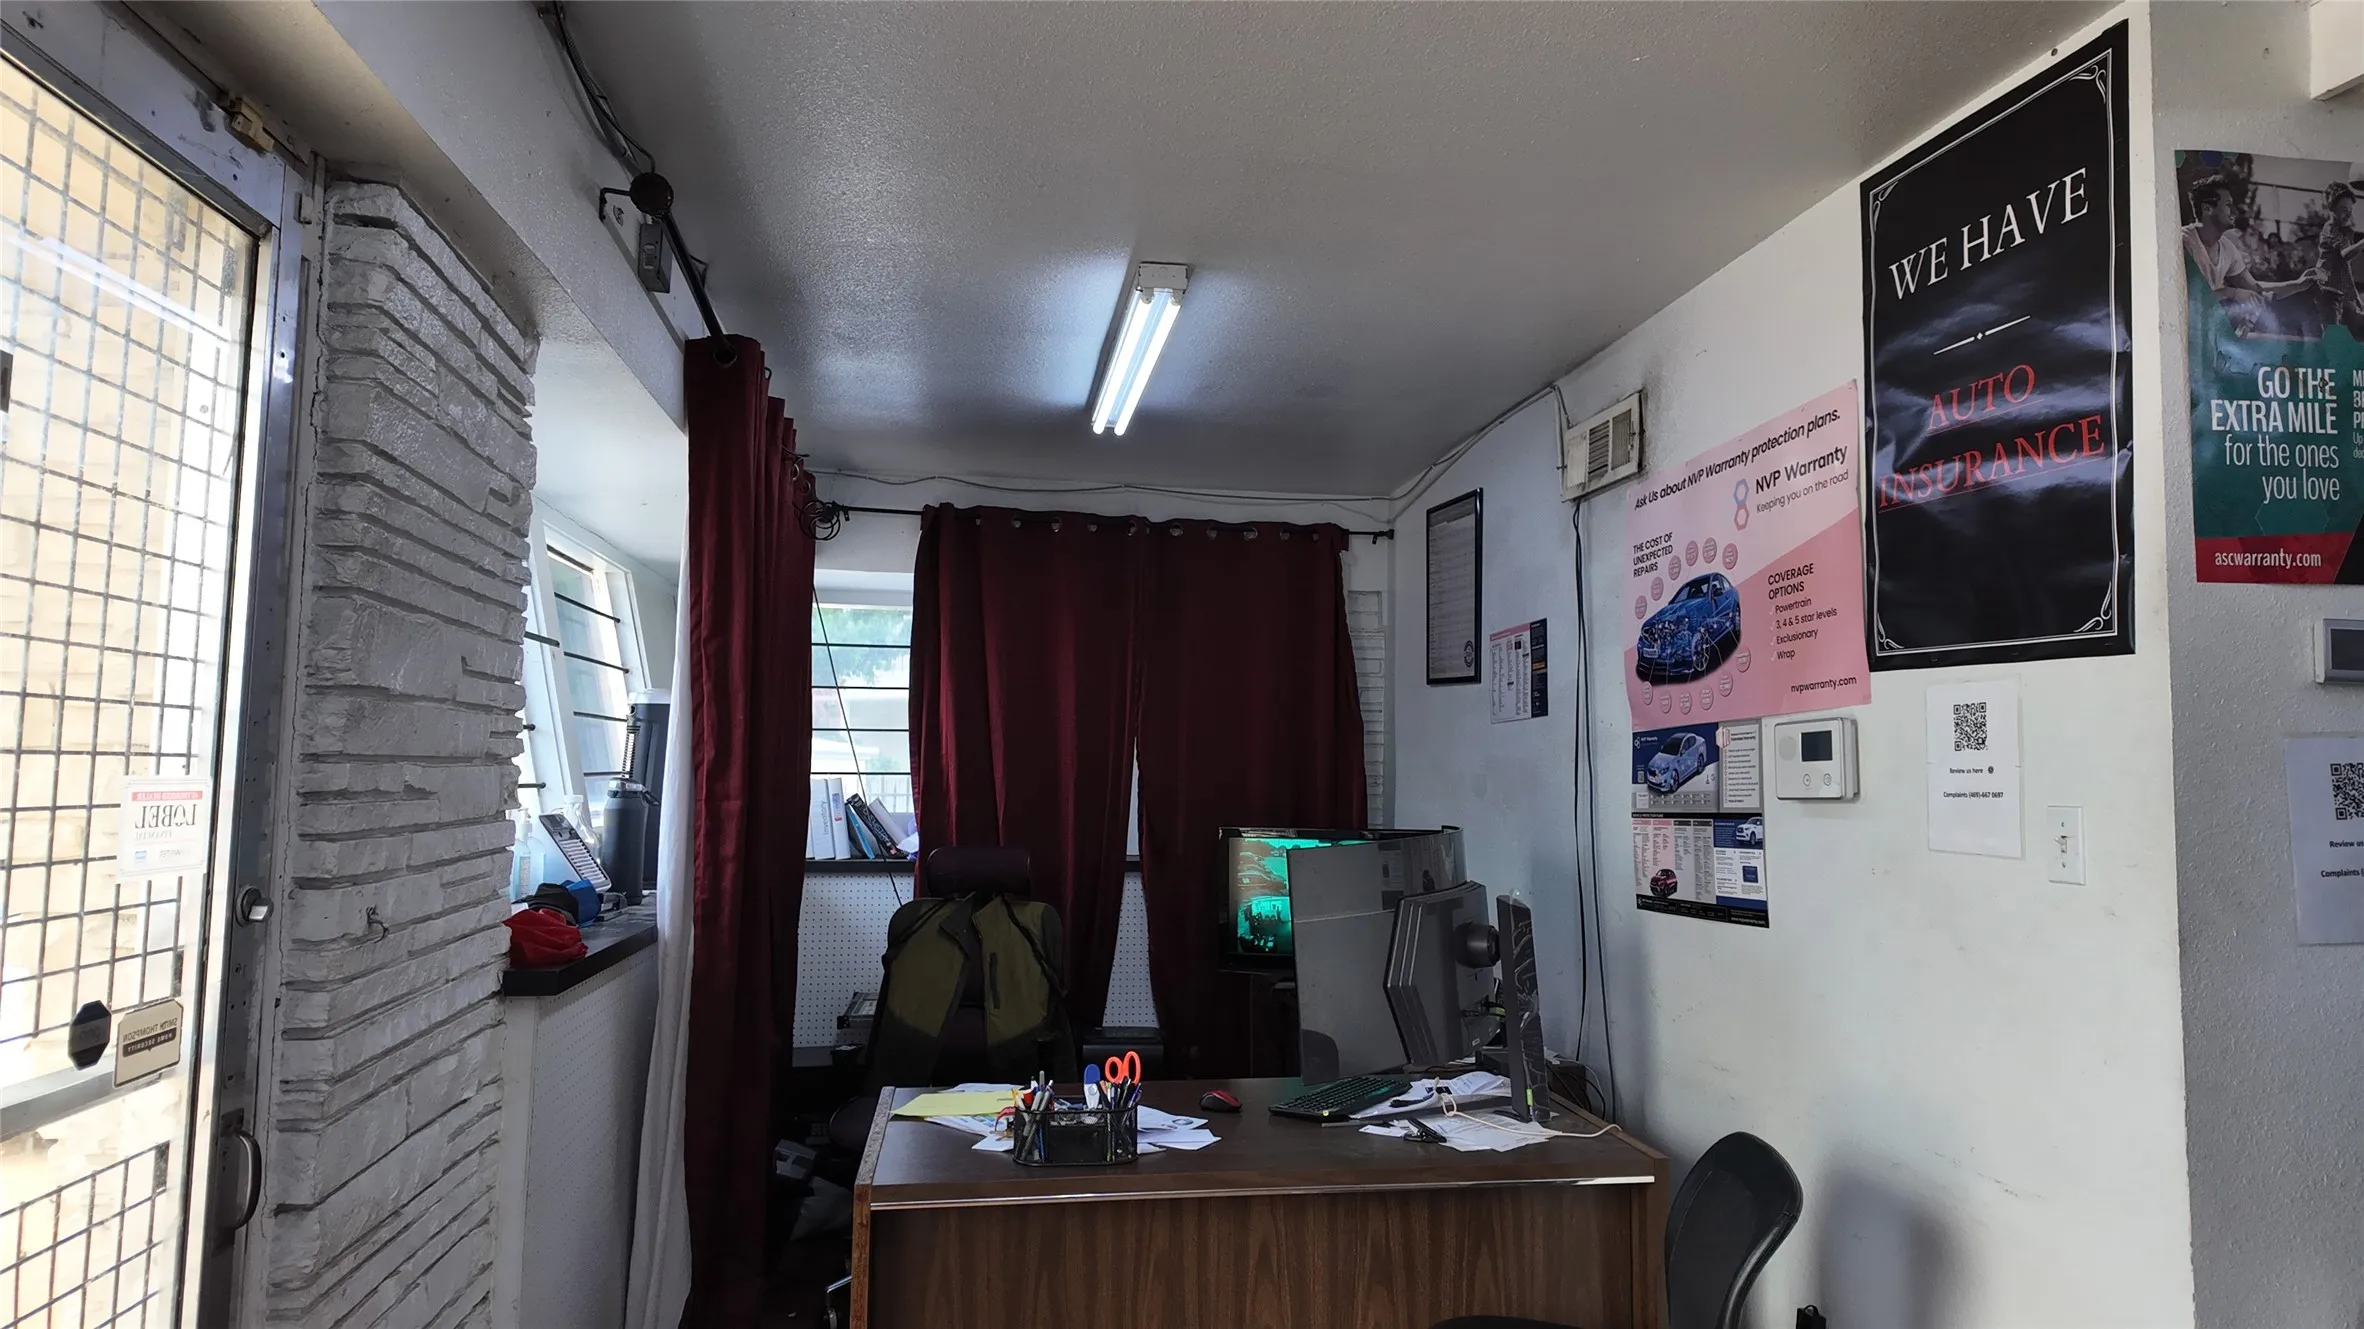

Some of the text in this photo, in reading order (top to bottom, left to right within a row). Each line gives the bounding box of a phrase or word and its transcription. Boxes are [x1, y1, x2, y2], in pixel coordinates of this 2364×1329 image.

[1888, 167, 2089, 300] WE HAVE
[2257, 366, 2337, 400] GO THE
[1928, 364, 2035, 430] AUTO
[2210, 400, 2338, 434] EXTRA MILE
[1634, 409, 1841, 511] Ask Us about NVP Warranty protection plans.
[1879, 415, 2105, 508] INSURANCE
[2224, 434, 2340, 468] for the ones
[1755, 445, 1848, 494] NVP Warranty
[1756, 468, 1849, 513] Keeping you on the road
[2262, 468, 2340, 504] you love
[1633, 531, 1673, 555] THE COST OF
[1633, 544, 1674, 566] UNEXPECTED
[1633, 561, 1659, 578] REPAIRS
[2215, 547, 2322, 569] ascwarranty.com
[1767, 562, 1815, 586] COVERAGE
[1768, 580, 1805, 600] OPTIONS
[1775, 596, 1812, 614] Powertrain
[1782, 617, 1788, 627] 4
[1788, 616, 1794, 627] &
[1794, 614, 1800, 625] 5
[1800, 612, 1815, 624] star
[1815, 607, 1838, 621] levels
[1776, 628, 1819, 645] Exclusionary
[1776, 649, 1796, 661] Wrap
[1790, 676, 1858, 694] nvpwarranty.com
[1943, 791, 1968, 799] Complaints
[821, 800, 830, 836] Inventory
[2329, 840, 2355, 848] Review
[2320, 869, 2360, 878] Complaints
